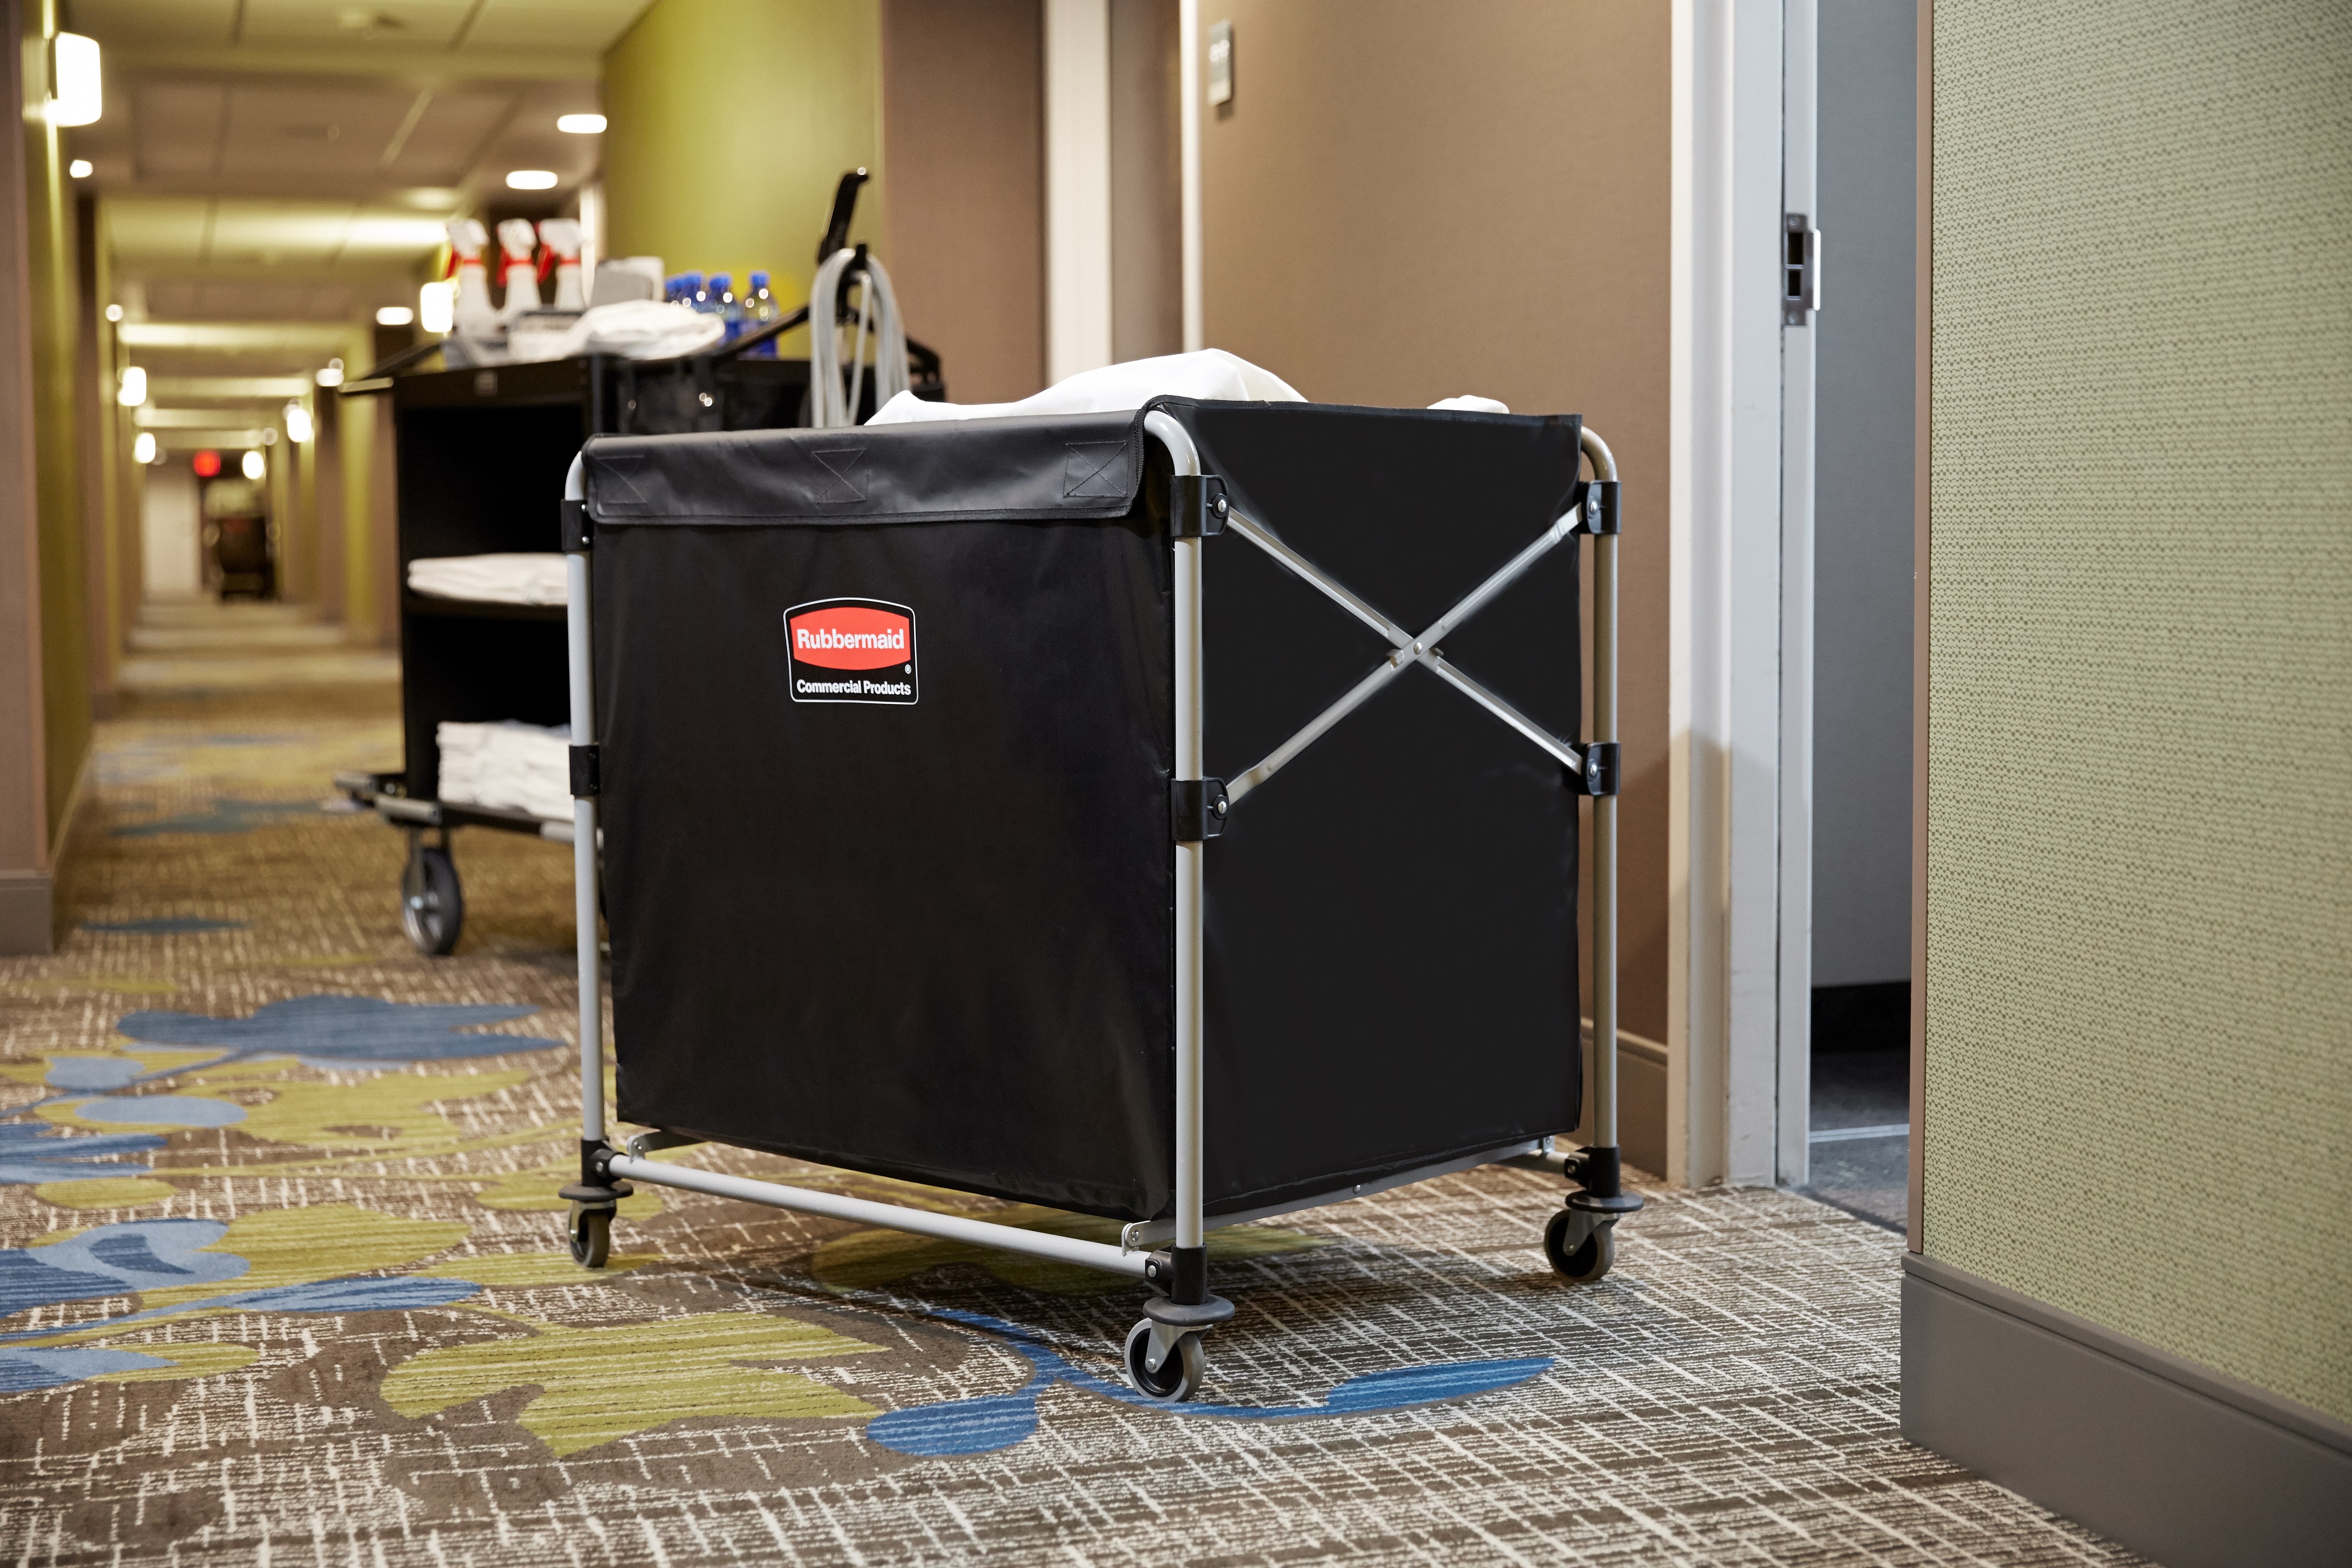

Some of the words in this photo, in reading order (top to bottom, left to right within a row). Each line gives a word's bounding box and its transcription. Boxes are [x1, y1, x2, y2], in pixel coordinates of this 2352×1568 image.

[797, 628, 904, 649] Rubbermaid
[797, 679, 862, 693] Commercial
[863, 680, 911, 695] Products
